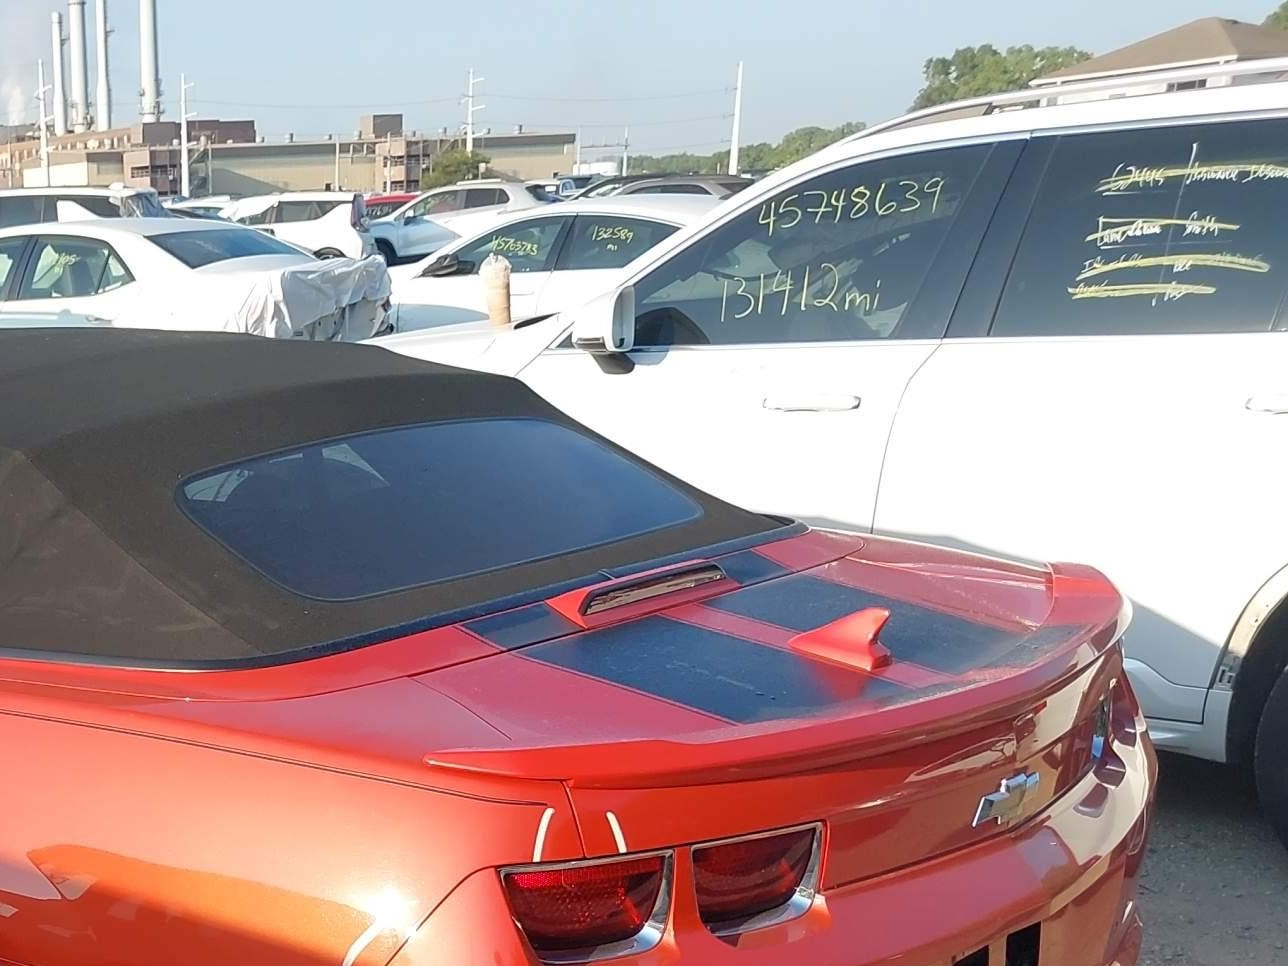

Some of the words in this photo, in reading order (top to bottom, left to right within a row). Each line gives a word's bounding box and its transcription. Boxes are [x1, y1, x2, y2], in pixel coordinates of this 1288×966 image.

[592, 225, 634, 244] 132589
[758, 177, 945, 236] 45748639
[720, 263, 881, 322] 131412mi
